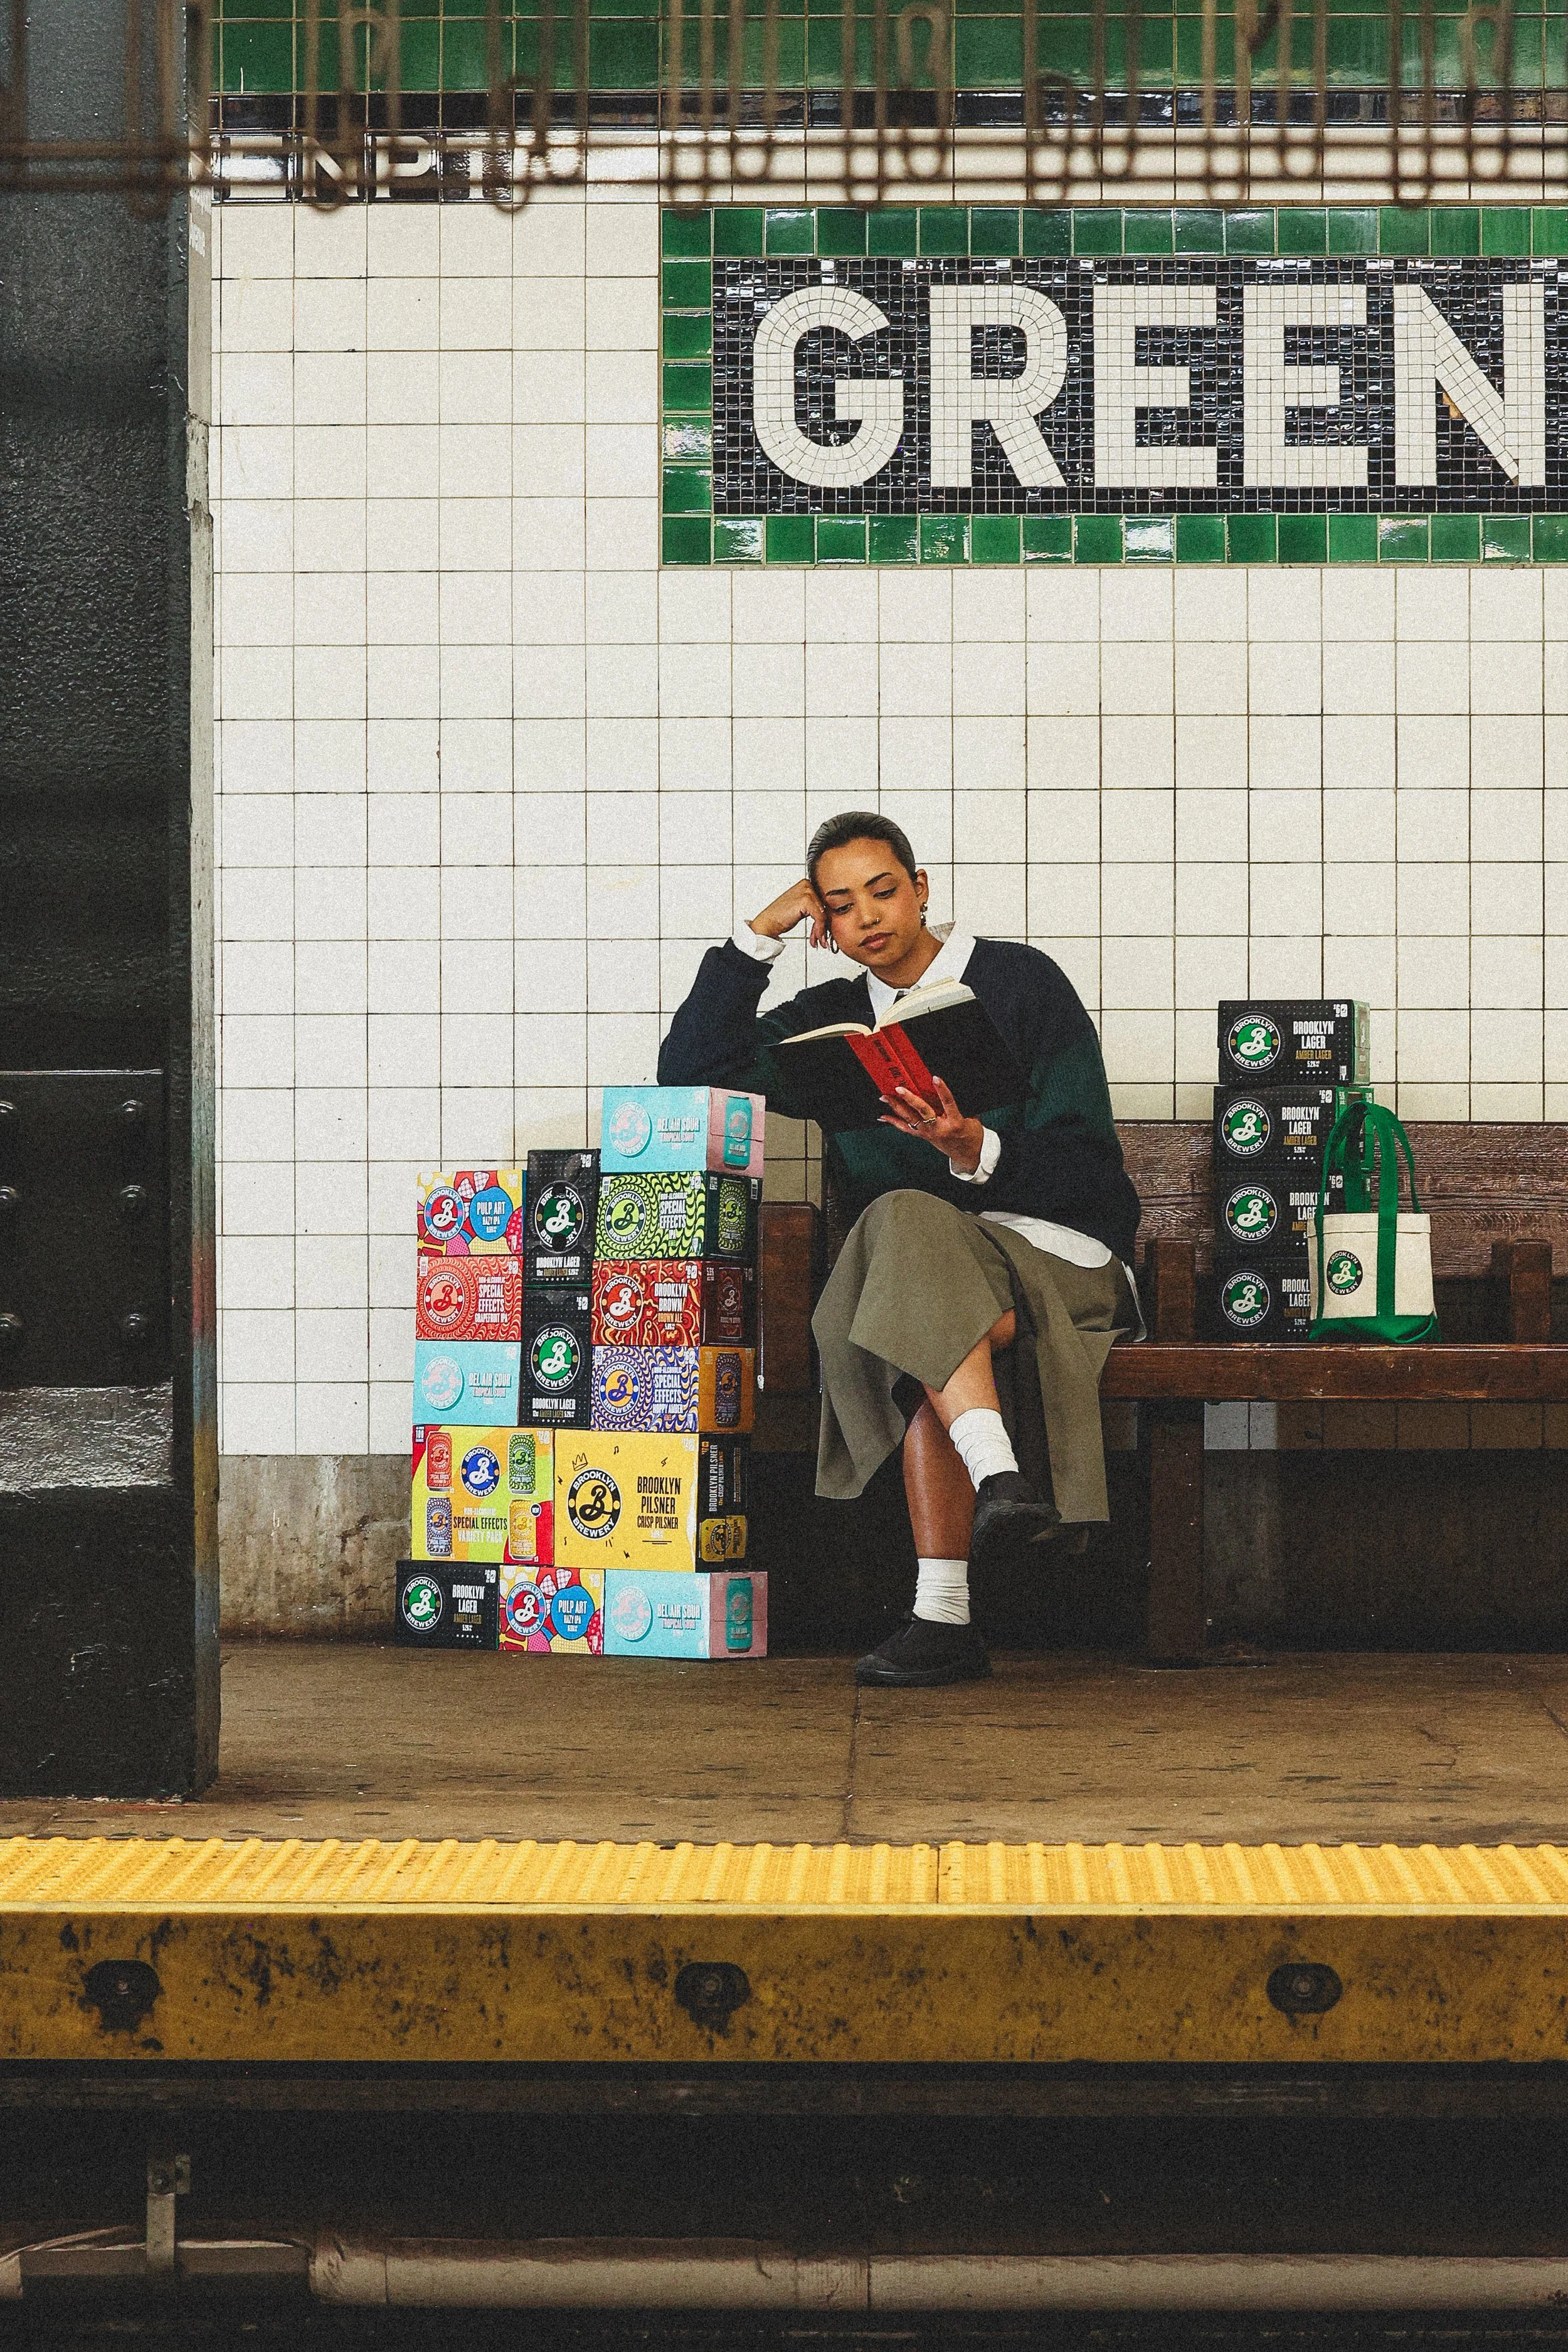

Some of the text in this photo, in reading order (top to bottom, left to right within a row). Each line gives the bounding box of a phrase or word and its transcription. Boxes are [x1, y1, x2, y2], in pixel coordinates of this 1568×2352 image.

[754, 284, 1545, 487] GREEN
[1234, 1017, 1274, 1033] BROOKLYN
[1293, 1021, 1334, 1034] BROOKLYN
[1301, 1036, 1326, 1049] LAGER
[1234, 1052, 1274, 1066] BREWERY
[1296, 1050, 1331, 1059] AMBER LAGER
[1227, 1103, 1264, 1119] BROOKLYN
[1281, 1107, 1320, 1120] BROOKLYN
[670, 1118, 681, 1131] AIR
[682, 1117, 700, 1131] SOUR
[1289, 1121, 1311, 1135] LAGER
[1227, 1137, 1264, 1152] BREWERY
[1283, 1136, 1317, 1145] AMBER LAGER
[428, 1189, 460, 1204] BROOKLYN
[610, 1193, 642, 1208] BROOKLYN
[1231, 1189, 1271, 1204] BROOKLYN
[477, 1202, 506, 1215] PULP ART
[660, 1200, 686, 1214] SPECIAL
[1298, 1207, 1316, 1220] LAGE
[482, 1216, 492, 1226] HAZY
[660, 1215, 686, 1229] EFFECTS
[428, 1223, 460, 1237] BREWERY
[609, 1227, 640, 1242] BREWERY
[1232, 1222, 1271, 1239] BREWERY
[536, 1256, 580, 1268] BROOKLYN LAGER
[1330, 1252, 1358, 1264] BROOKLYN
[429, 1274, 460, 1290] BROOKLYN
[605, 1278, 638, 1293] BROOKLYN
[1227, 1274, 1264, 1290] BROOKLYN
[1282, 1279, 1310, 1292] BROOKL
[1330, 1281, 1358, 1293] BREWERY
[479, 1285, 504, 1298] SPECIAL
[654, 1283, 688, 1297] BROOKLYN
[479, 1299, 504, 1312] EFFECTS
[659, 1298, 682, 1311] BROWN
[428, 1308, 460, 1323] BREWERY
[475, 1313, 500, 1323] GRAPEFRUIT
[605, 1312, 637, 1328] BREWERY
[658, 1313, 674, 1323] BROWN
[1227, 1309, 1264, 1325] BREWERY
[537, 1330, 575, 1348] BROOKLYN
[596, 1351, 601, 1360] 95
[536, 1370, 573, 1387] BREWERY
[603, 1364, 635, 1379] BROOKLYN
[481, 1373, 493, 1387] AIR
[494, 1373, 511, 1387] SOUR
[654, 1374, 681, 1388] SPECIAL
[655, 1389, 682, 1403] EFFECTS
[532, 1398, 576, 1409] BROOKLYN LAGER
[603, 1399, 635, 1414] BREWERY
[653, 1404, 683, 1414] HOPPY AMBER
[465, 1448, 496, 1463] BROOKLYN
[573, 1471, 617, 1492] BROOKLYN
[637, 1476, 681, 1495] BROOKLYN
[465, 1482, 495, 1496] BREWERY
[709, 1476, 718, 1512] BROOKLYN
[641, 1496, 675, 1515] PILSNER
[453, 1517, 507, 1530] SPECIAL EFFECTS
[573, 1517, 615, 1537] BREWERY
[637, 1516, 678, 1529] CRISP PILSNER
[458, 1530, 484, 1543] VARIETY
[486, 1530, 503, 1543] PACK
[407, 1579, 438, 1594] BROOKLYN
[452, 1584, 485, 1599] BROOKLYN
[511, 1584, 542, 1599] BROOKLYN
[458, 1599, 477, 1613] LAGER
[558, 1600, 588, 1614] PULP ART
[657, 1604, 701, 1619] BEL AIR SOUR
[407, 1613, 437, 1628] BREWERY
[469, 1614, 482, 1624] LAGER
[511, 1619, 541, 1633] BREWERY
[563, 1615, 574, 1624] HAZY
